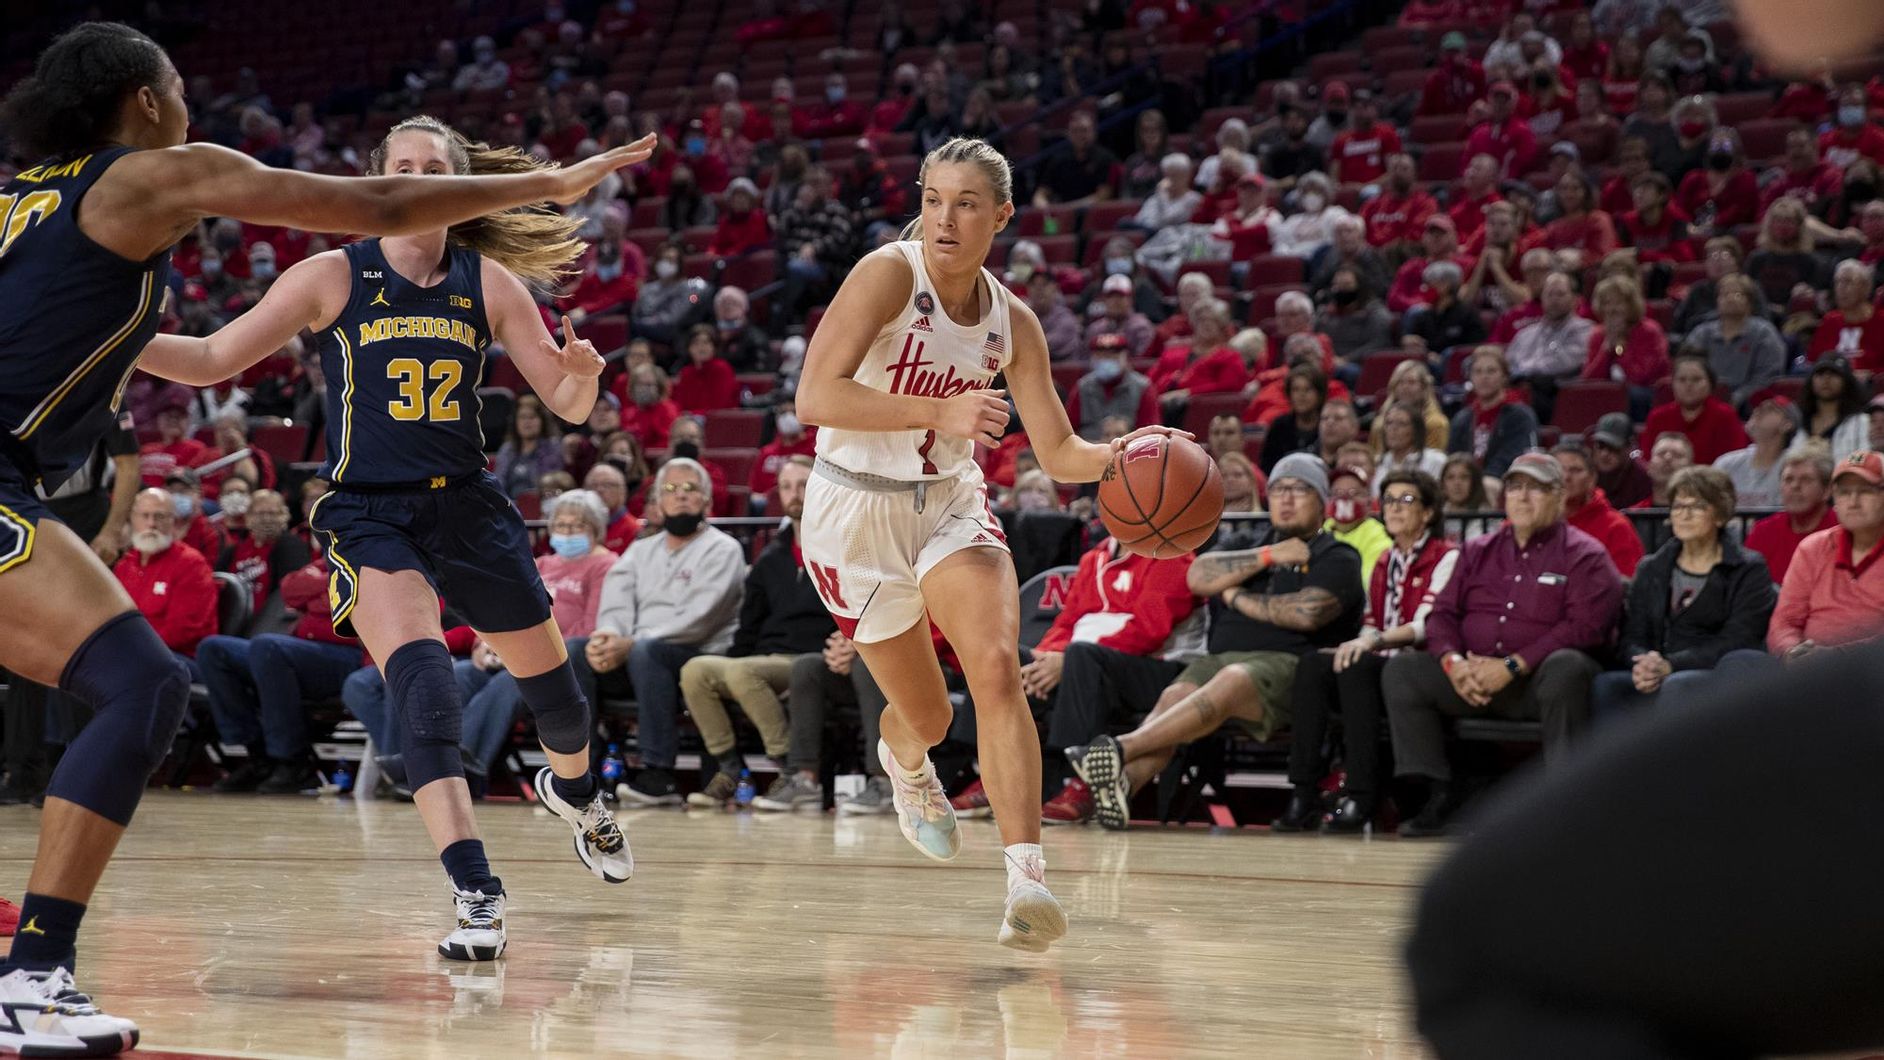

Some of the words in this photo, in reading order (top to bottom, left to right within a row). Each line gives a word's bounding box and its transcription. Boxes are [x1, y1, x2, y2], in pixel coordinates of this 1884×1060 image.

[360, 316, 476, 352] MICHIGAN
[911, 323, 934, 333] adidas
[386, 358, 463, 422] 32
[808, 560, 849, 611] N
